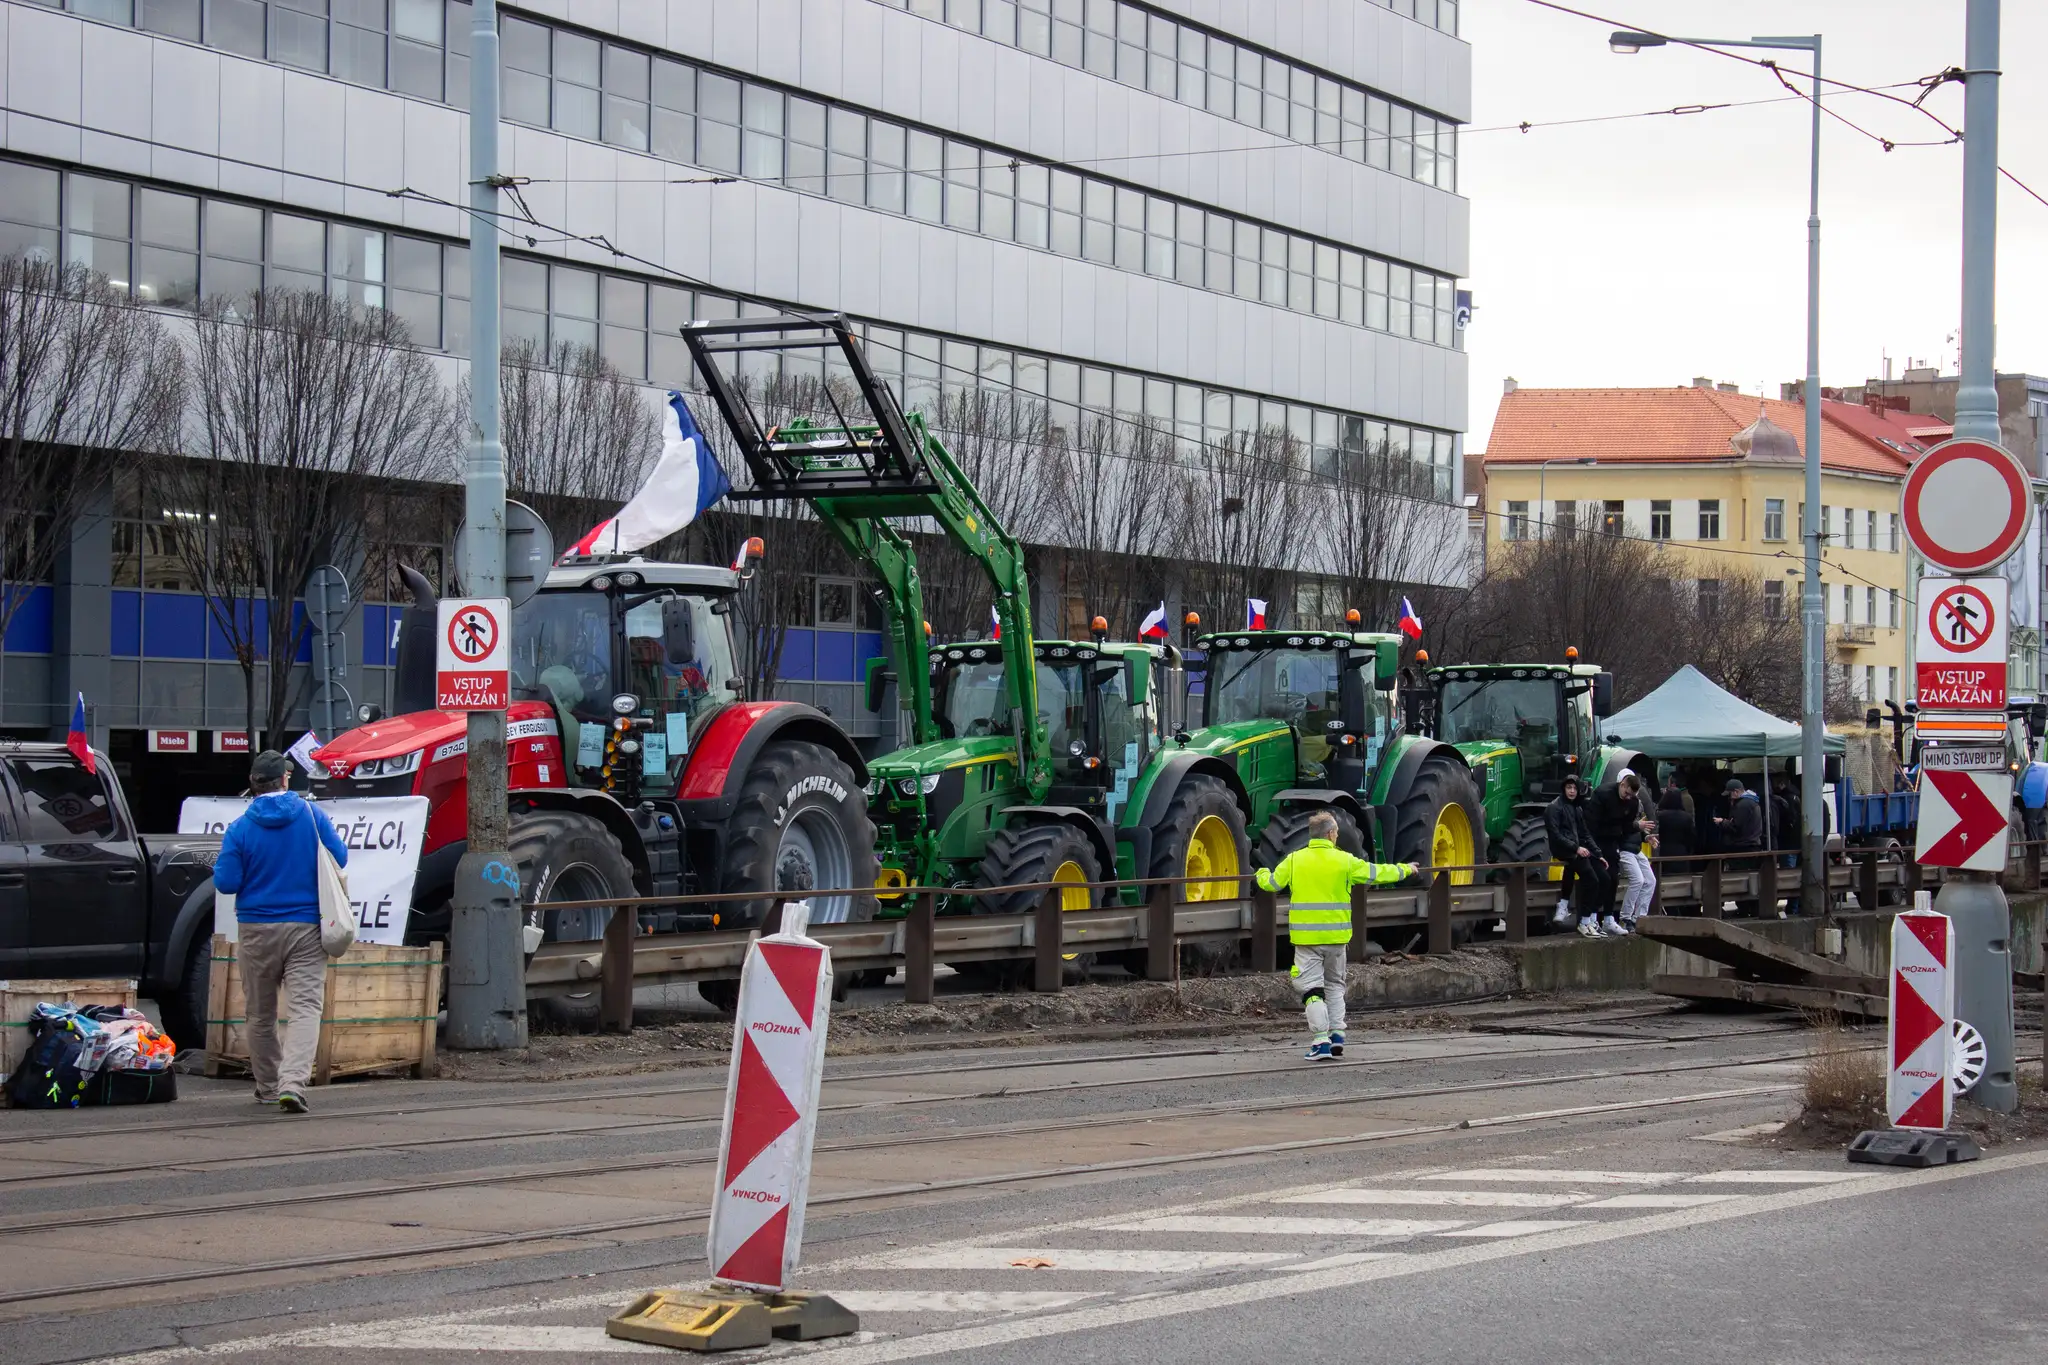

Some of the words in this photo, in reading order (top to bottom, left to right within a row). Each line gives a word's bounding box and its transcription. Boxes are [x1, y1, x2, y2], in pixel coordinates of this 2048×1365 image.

[453, 678, 493, 690] VSTUP
[1936, 671, 1986, 685] VSTUP
[439, 691, 498, 706] ZAKÁZÁN
[502, 694, 507, 705] !
[1920, 686, 1992, 703] ZAKÁZÁN
[1999, 690, 2004, 703] !
[519, 722, 549, 735] FERGUSON
[160, 736, 186, 745] Miele
[224, 737, 249, 746] Miele
[441, 742, 465, 757] 8740
[1925, 754, 1951, 766] MIMO
[1953, 753, 1987, 765] STAVBU
[1989, 752, 2003, 764] DP
[786, 775, 848, 809] MICHELIN
[329, 815, 406, 855] DĚLCI,
[1901, 965, 1937, 974] PROZNAK
[752, 1022, 801, 1036] PROZNAK
[1901, 1070, 1938, 1079] PROZNAK
[732, 1189, 782, 1203] PROZNAK
